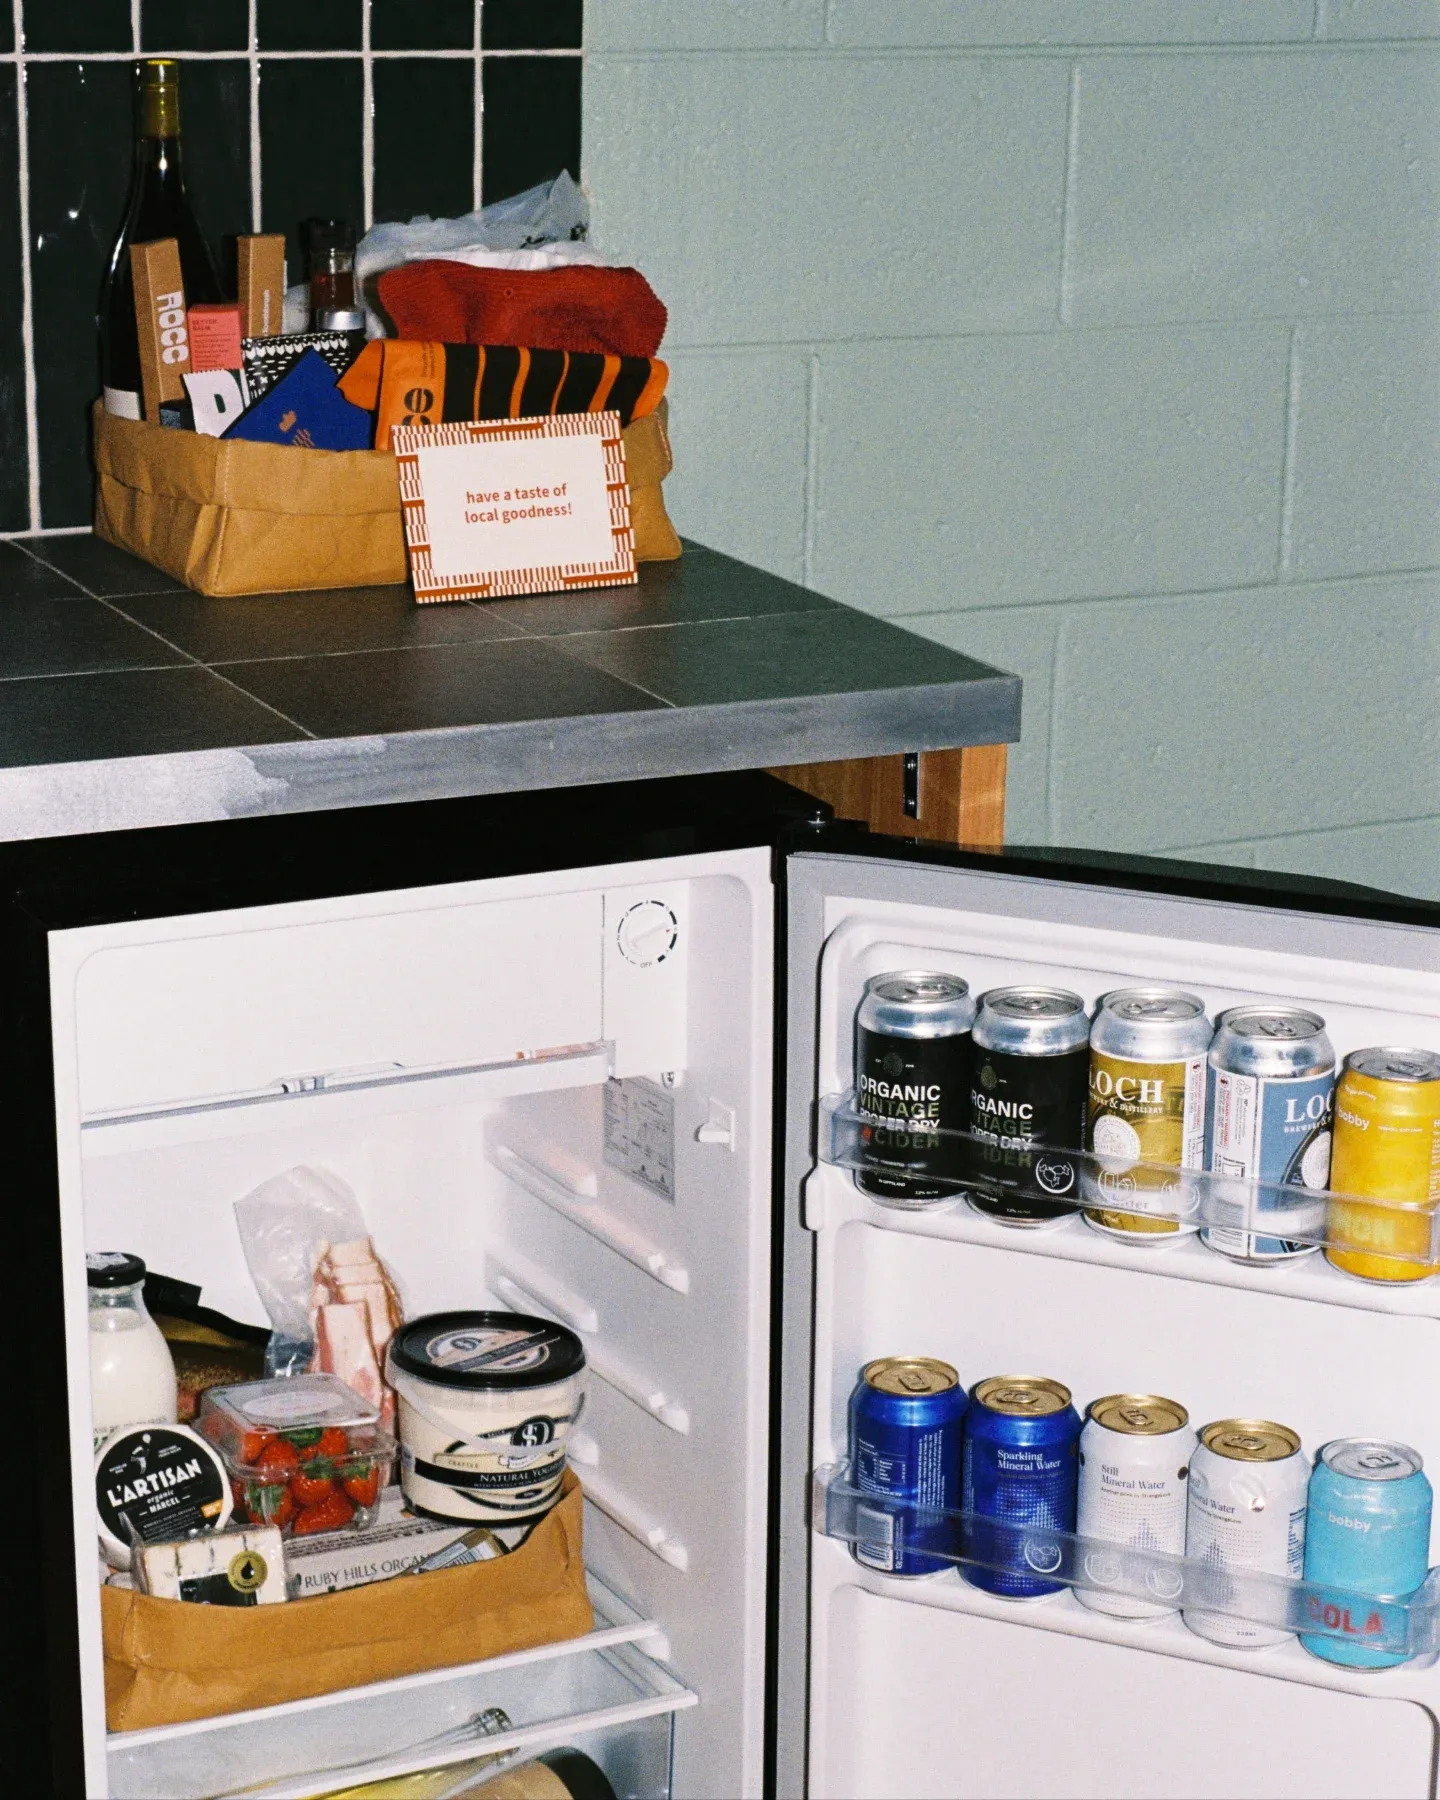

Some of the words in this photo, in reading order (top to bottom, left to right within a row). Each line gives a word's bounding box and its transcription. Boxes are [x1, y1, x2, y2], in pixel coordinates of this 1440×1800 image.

[157, 291, 189, 365] ROCC
[466, 489, 500, 505] have
[503, 490, 511, 501] a
[514, 486, 550, 500] taste
[553, 482, 569, 498] of
[465, 508, 499, 524] local
[502, 502, 573, 524] goodness!
[860, 1074, 941, 1101] ORGANIC
[861, 1091, 940, 1118] VINTAGE
[971, 1089, 1033, 1120] RGANIC
[1109, 1096, 1118, 1109] &
[1120, 1103, 1163, 1114] DISTILLERY
[908, 1119, 941, 1134] DRY
[1337, 1105, 1370, 1132] bobby
[875, 1126, 940, 1149] CIDER
[1000, 1136, 1033, 1152] DRY
[983, 1145, 1033, 1168] IDER
[997, 1449, 1044, 1462] Sparkling
[997, 1460, 1034, 1471] Mineral
[1036, 1460, 1062, 1470] Water
[480, 1473, 528, 1482] NATURAL
[1101, 1464, 1119, 1477] Still
[107, 1458, 202, 1508] L'ARTISAN
[1101, 1474, 1135, 1489] Mineral
[1138, 1480, 1166, 1490] Water
[146, 1489, 174, 1504] organic
[149, 1497, 180, 1513] MARCEL
[1210, 1499, 1235, 1514] Water
[1328, 1511, 1371, 1533] bobby
[304, 1570, 340, 1589] RUBY
[344, 1563, 378, 1581] HILLS
[1306, 1596, 1384, 1636] COLA
